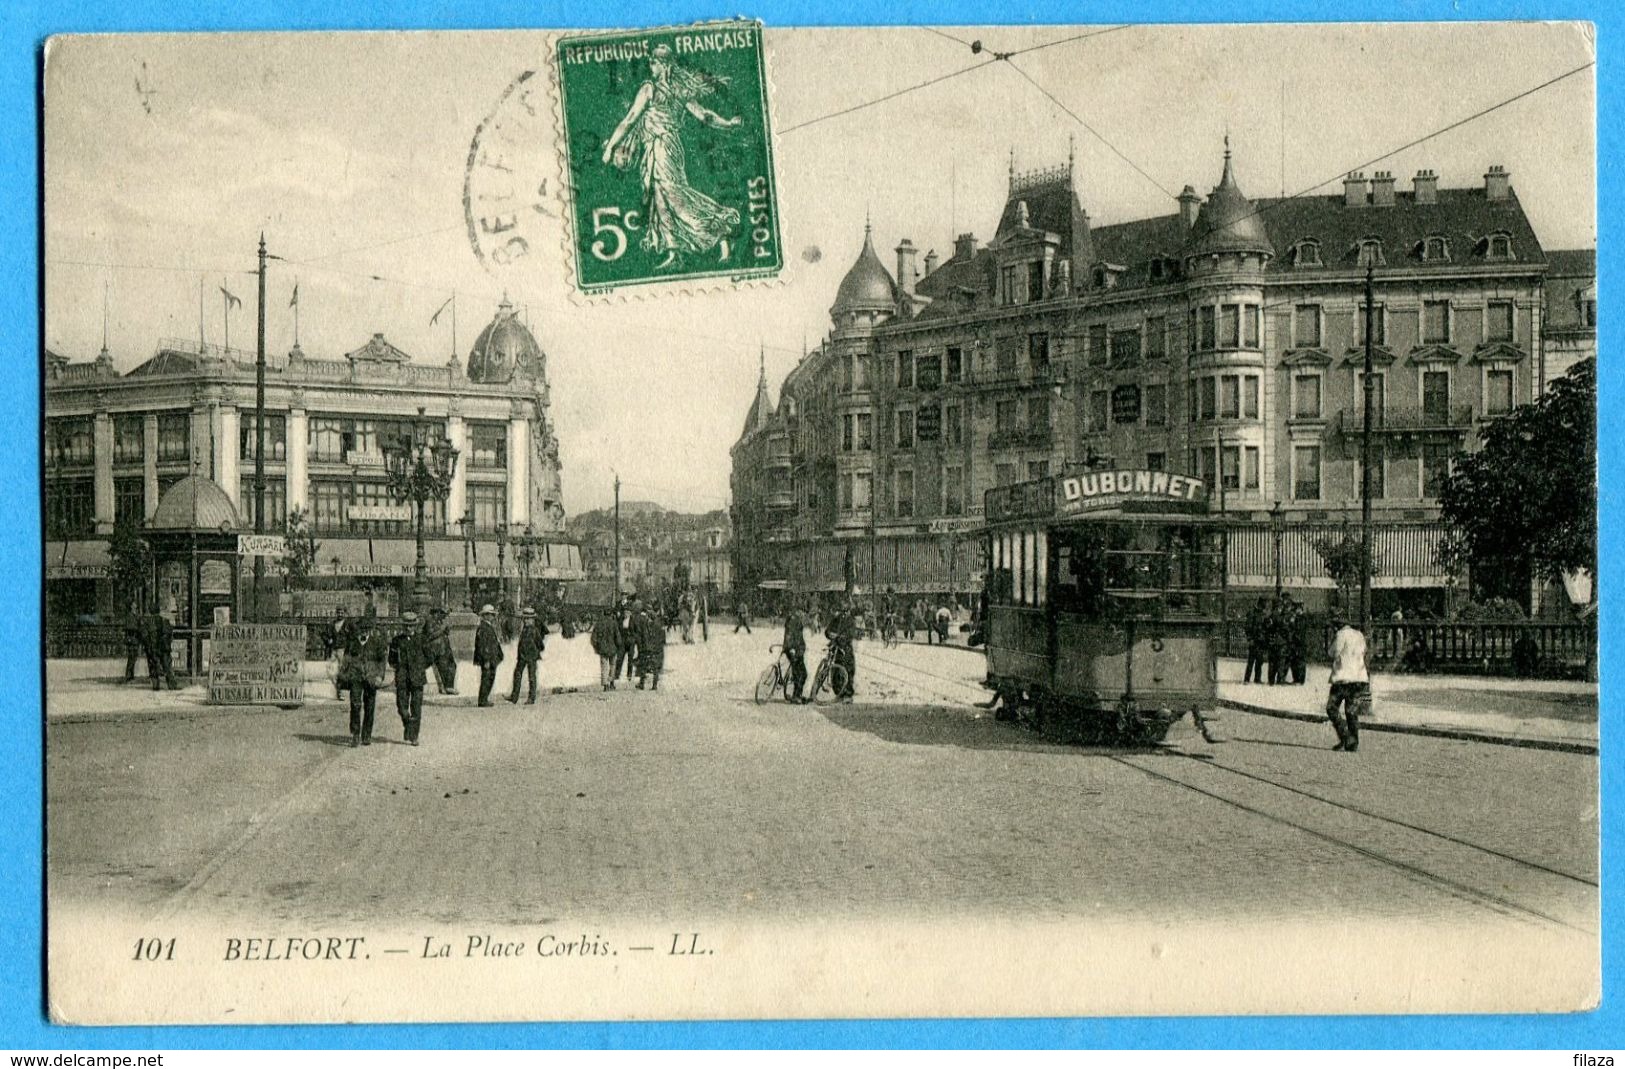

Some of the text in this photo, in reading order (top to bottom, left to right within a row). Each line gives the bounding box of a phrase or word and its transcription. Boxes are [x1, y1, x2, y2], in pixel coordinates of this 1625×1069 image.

[676, 30, 753, 53] FRANÇAISE
[747, 175, 771, 257] POSTES
[1063, 470, 1203, 500] DUBONNET
[340, 564, 393, 575] GALERIES
[401, 565, 456, 576] MORNES
[257, 687, 302, 700] KURSAAL
[131, 933, 715, 961] 101 BELFORT. La Place Corbis. LL.
